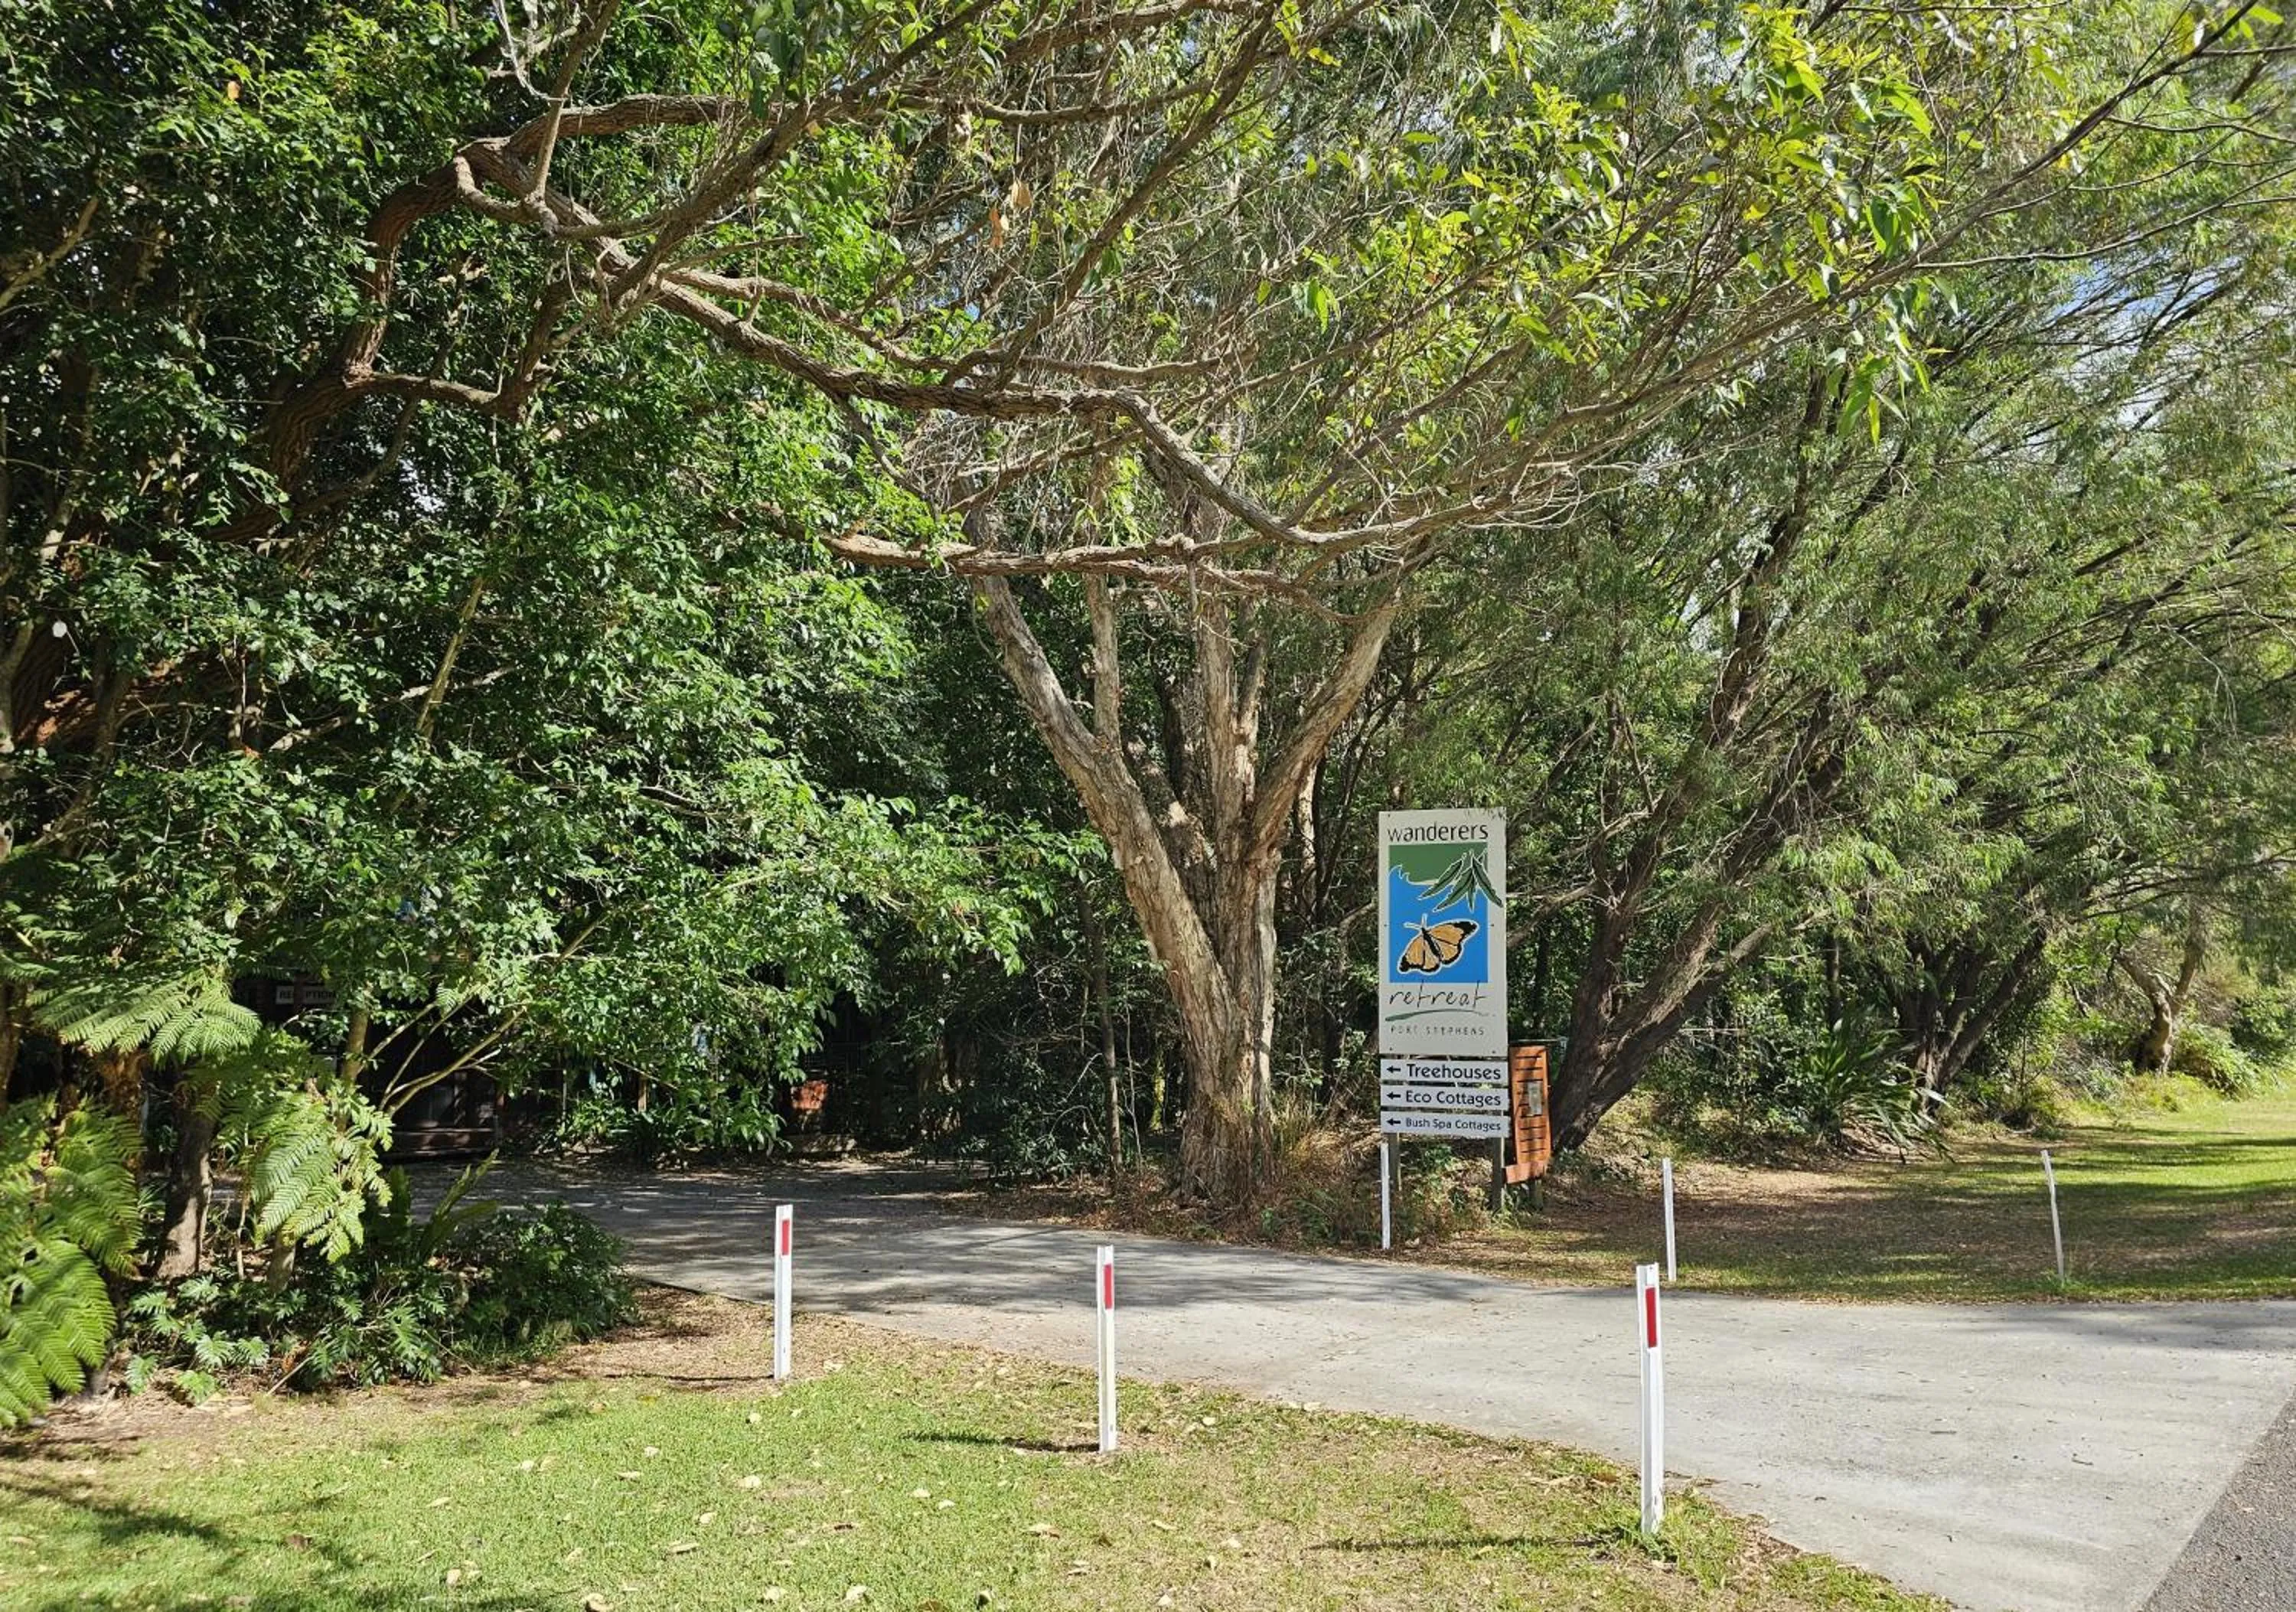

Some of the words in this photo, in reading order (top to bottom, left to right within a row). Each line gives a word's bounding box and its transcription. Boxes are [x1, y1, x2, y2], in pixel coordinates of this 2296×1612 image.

[1388, 821, 1489, 841] wanderers
[1389, 980, 1486, 1008] retreat
[1391, 1026, 1417, 1034] PORT
[1426, 1026, 1484, 1036] STEPHENS
[1407, 1063, 1502, 1080] Treehouses
[1406, 1090, 1432, 1103] Eco
[1437, 1091, 1502, 1108] Cottages
[1405, 1117, 1430, 1127] Bush
[1433, 1118, 1452, 1130] Spa
[1455, 1120, 1502, 1132] Cottages
